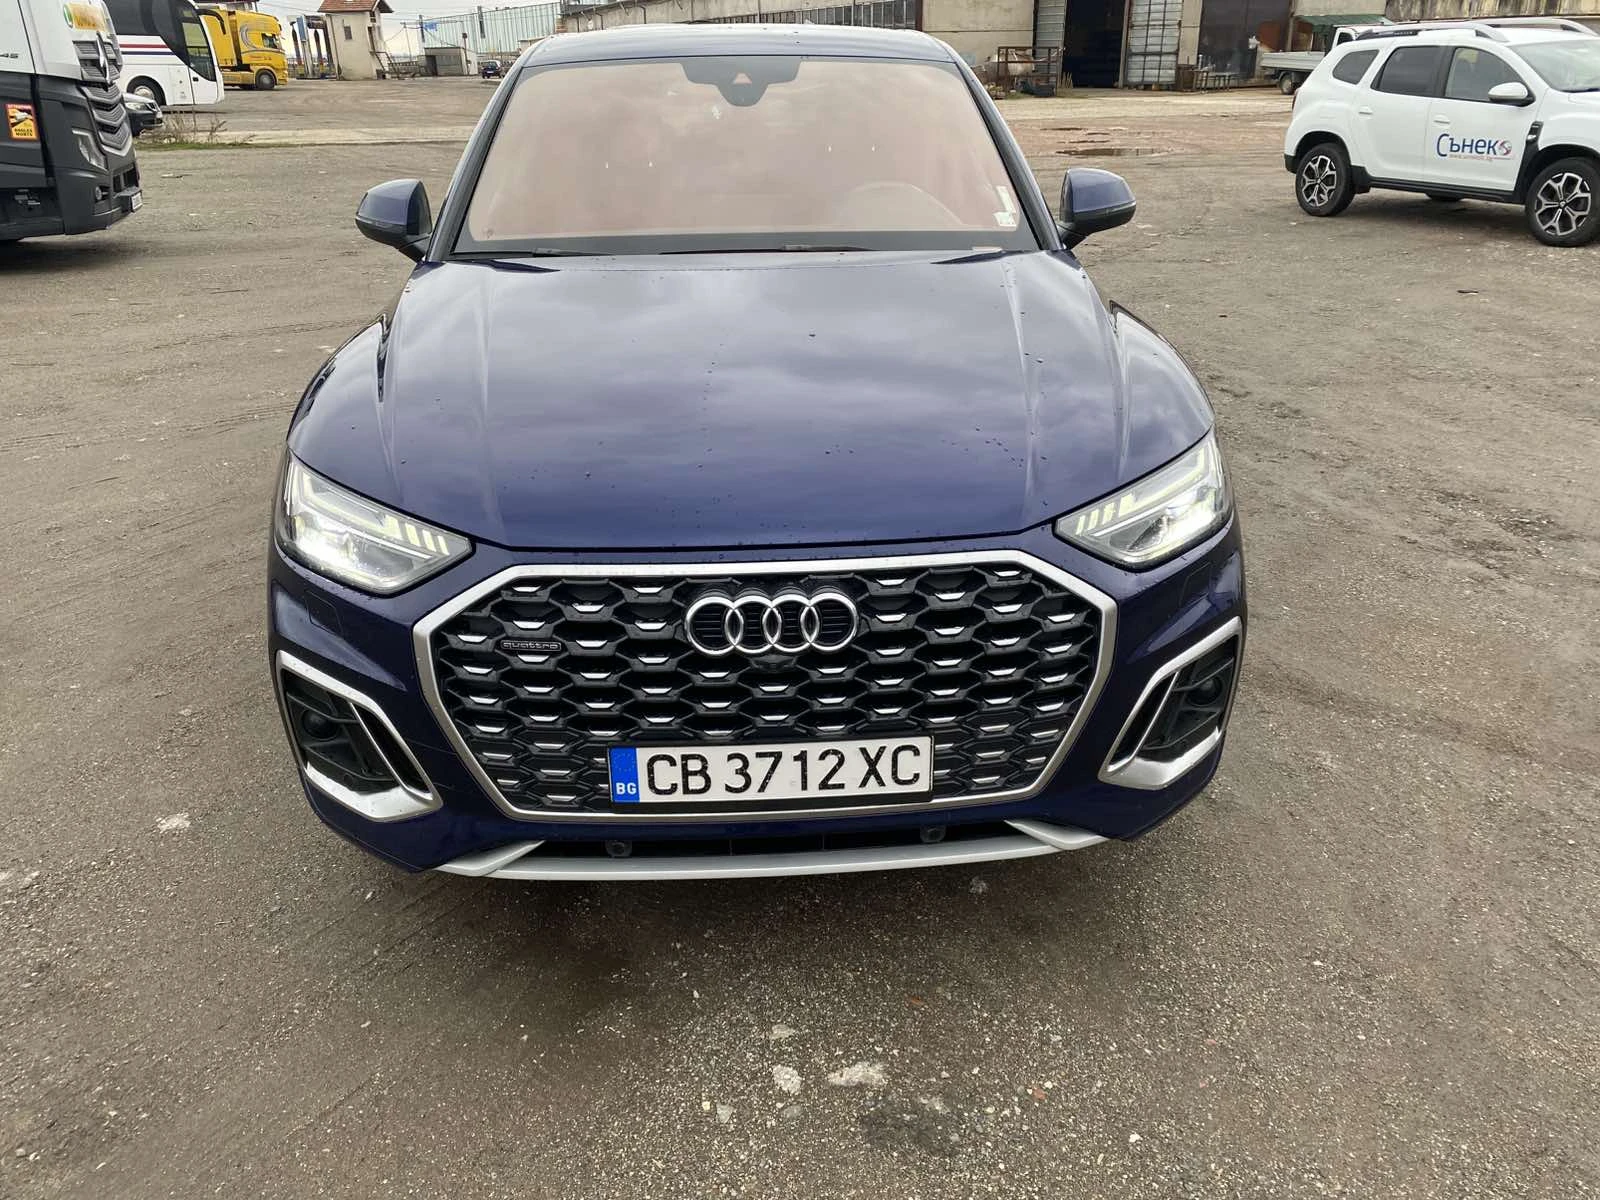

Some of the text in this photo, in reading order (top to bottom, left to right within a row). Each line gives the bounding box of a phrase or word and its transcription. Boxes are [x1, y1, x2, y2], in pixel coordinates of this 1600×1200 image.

[503, 641, 558, 649] quattro
[616, 744, 921, 795] BG CB 3712 XC
